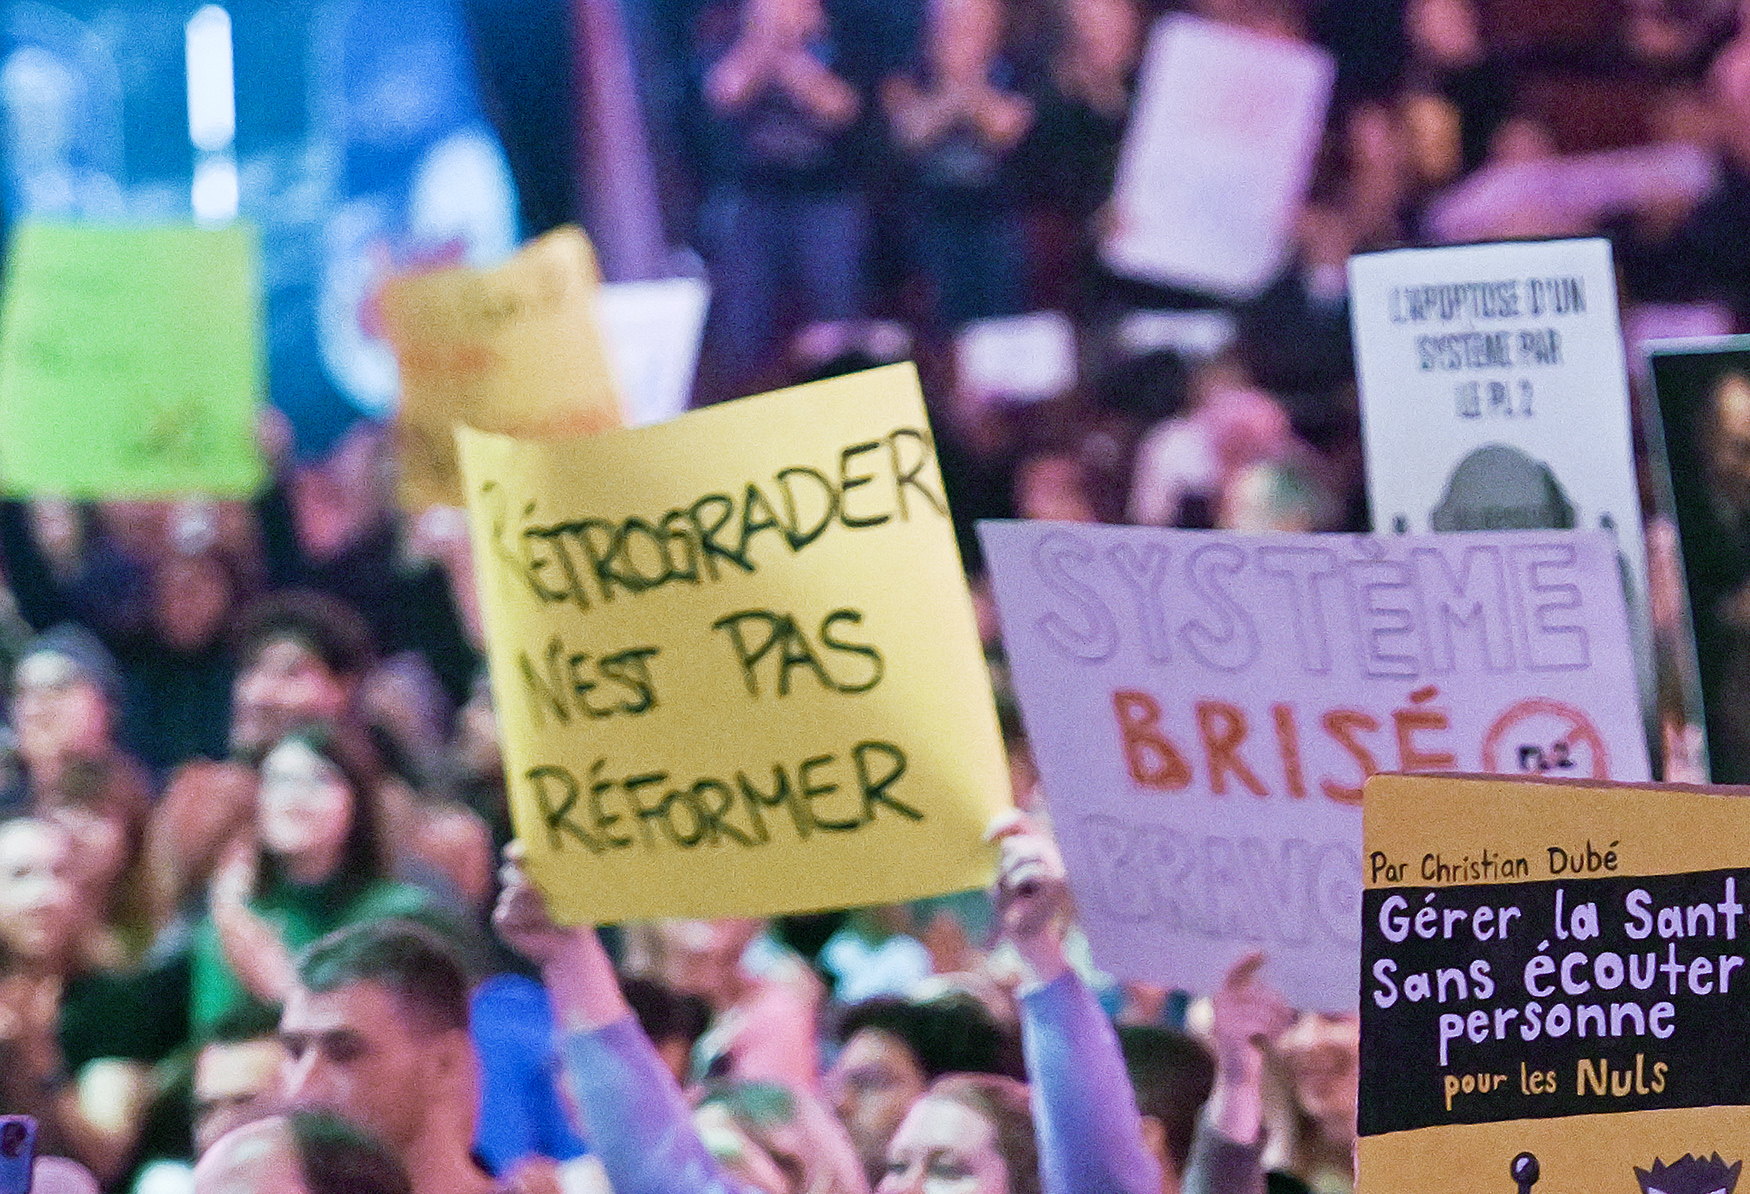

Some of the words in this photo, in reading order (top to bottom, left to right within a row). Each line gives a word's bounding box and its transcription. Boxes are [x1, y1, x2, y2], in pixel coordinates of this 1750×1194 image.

[1031, 530, 1592, 680] SYSTÈME
[712, 608, 885, 700] PAS
[1110, 685, 1458, 806] BRISÉ
[524, 739, 925, 856] RÉFORMER
[1369, 850, 1409, 885] Par
[1420, 848, 1530, 883] Christian
[1547, 839, 1621, 874] Dubé
[1377, 891, 1522, 944] Gérer
[1554, 887, 1601, 942] la
[1371, 957, 1497, 1010] Sans
[1523, 939, 1745, 998] écouter
[1438, 999, 1677, 1067] personne
[1443, 1071, 1509, 1112] pour
[1519, 1060, 1558, 1097] les
[1575, 1052, 1670, 1098] Nuls
